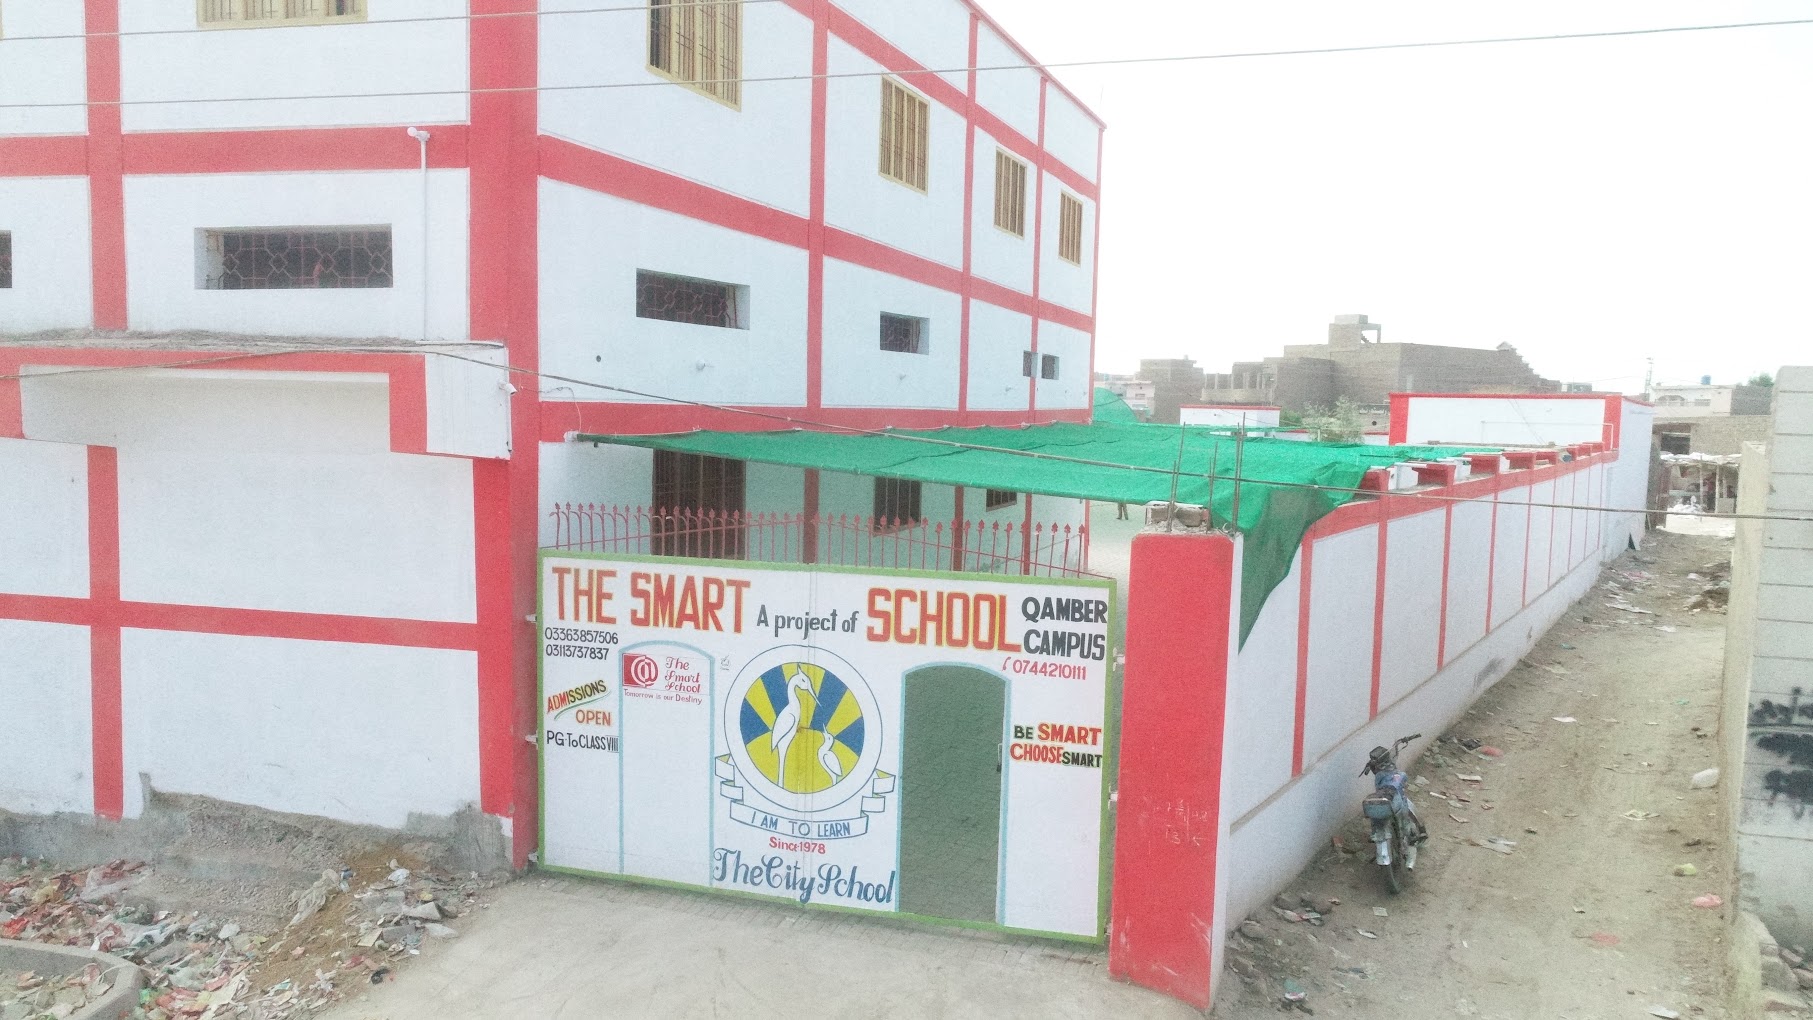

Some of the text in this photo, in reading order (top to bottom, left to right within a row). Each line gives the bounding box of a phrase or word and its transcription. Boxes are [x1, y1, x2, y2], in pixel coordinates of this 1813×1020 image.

[552, 566, 751, 634] THE SMART
[1021, 596, 1108, 624] QAMBER
[756, 604, 860, 641] A project of
[866, 587, 1022, 653] SCHOOL
[544, 627, 619, 645] 03363857506
[1023, 629, 1106, 661] CAMPUS
[545, 644, 610, 661] 03113737837
[665, 656, 690, 671] The
[664, 670, 701, 683] Smart
[1012, 659, 1087, 680] 0744210111
[546, 679, 608, 715] ADMISSIONS
[623, 688, 654, 699] Tomorrow
[675, 693, 703, 706] Destiny
[664, 681, 701, 693] School
[575, 709, 613, 727] OPEN
[578, 734, 607, 751] CLASS
[1013, 722, 1102, 746] BE SMART
[1009, 742, 1103, 768] CHOOSE SMART
[751, 811, 851, 838] I AM TO LEARN
[799, 841, 826, 855] 1978
[713, 847, 896, 904] The City School
